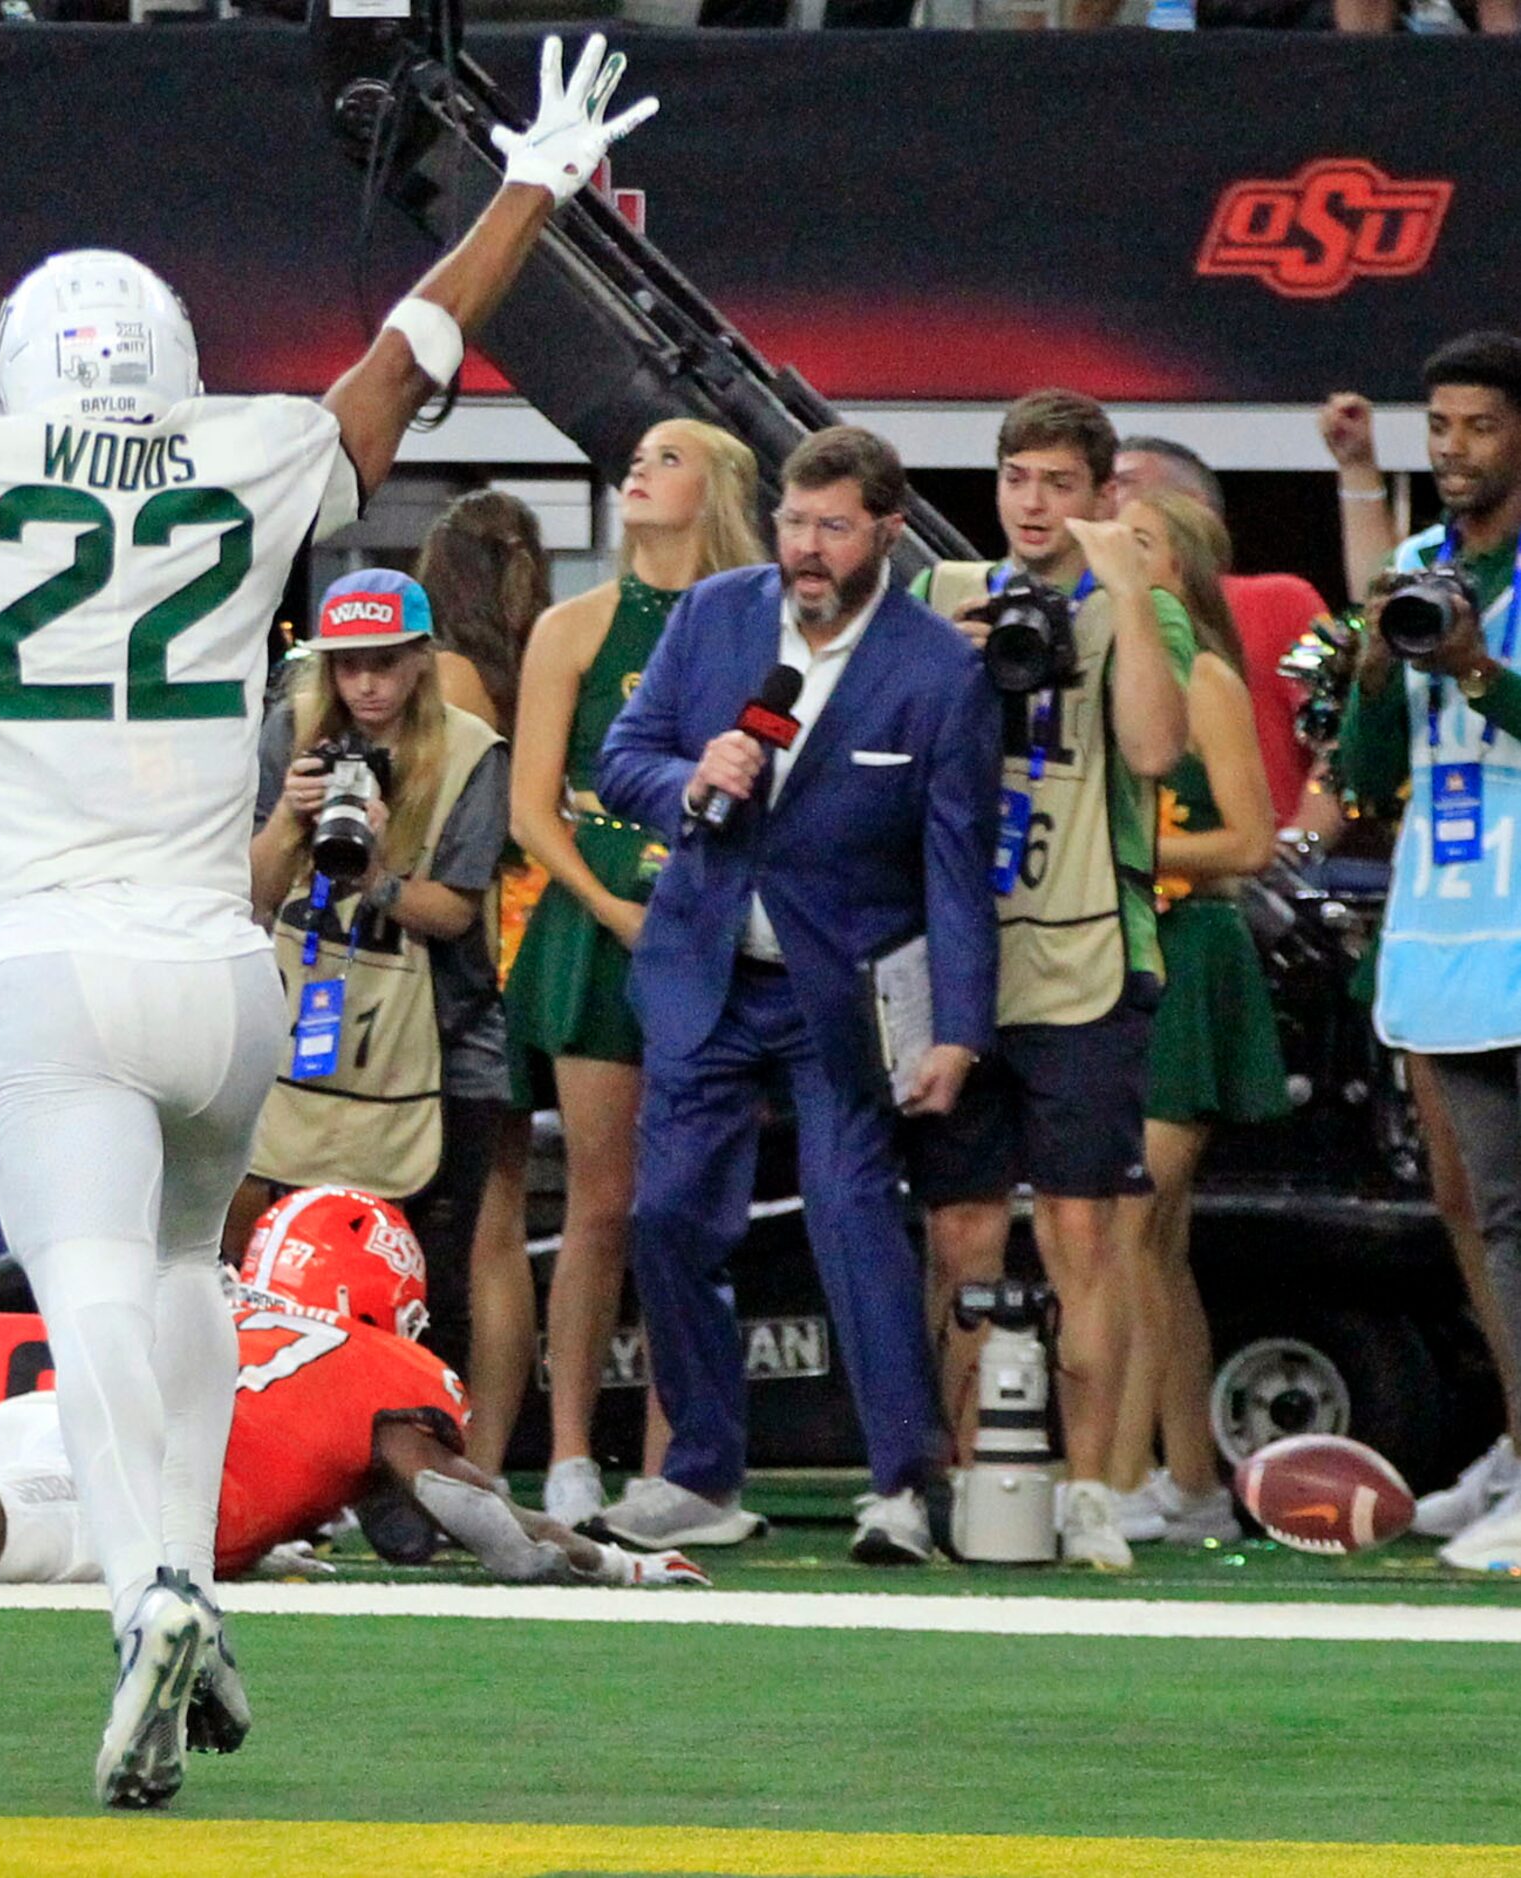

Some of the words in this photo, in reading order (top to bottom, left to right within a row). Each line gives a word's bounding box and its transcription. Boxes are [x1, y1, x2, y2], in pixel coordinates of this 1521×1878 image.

[1196, 157, 1454, 298] OSU
[115, 341, 145, 353] UNITY
[81, 396, 137, 412] BAYLOR
[43, 422, 197, 491] WOODS
[329, 601, 394, 625] WACO
[279, 1238, 316, 1270] 27
